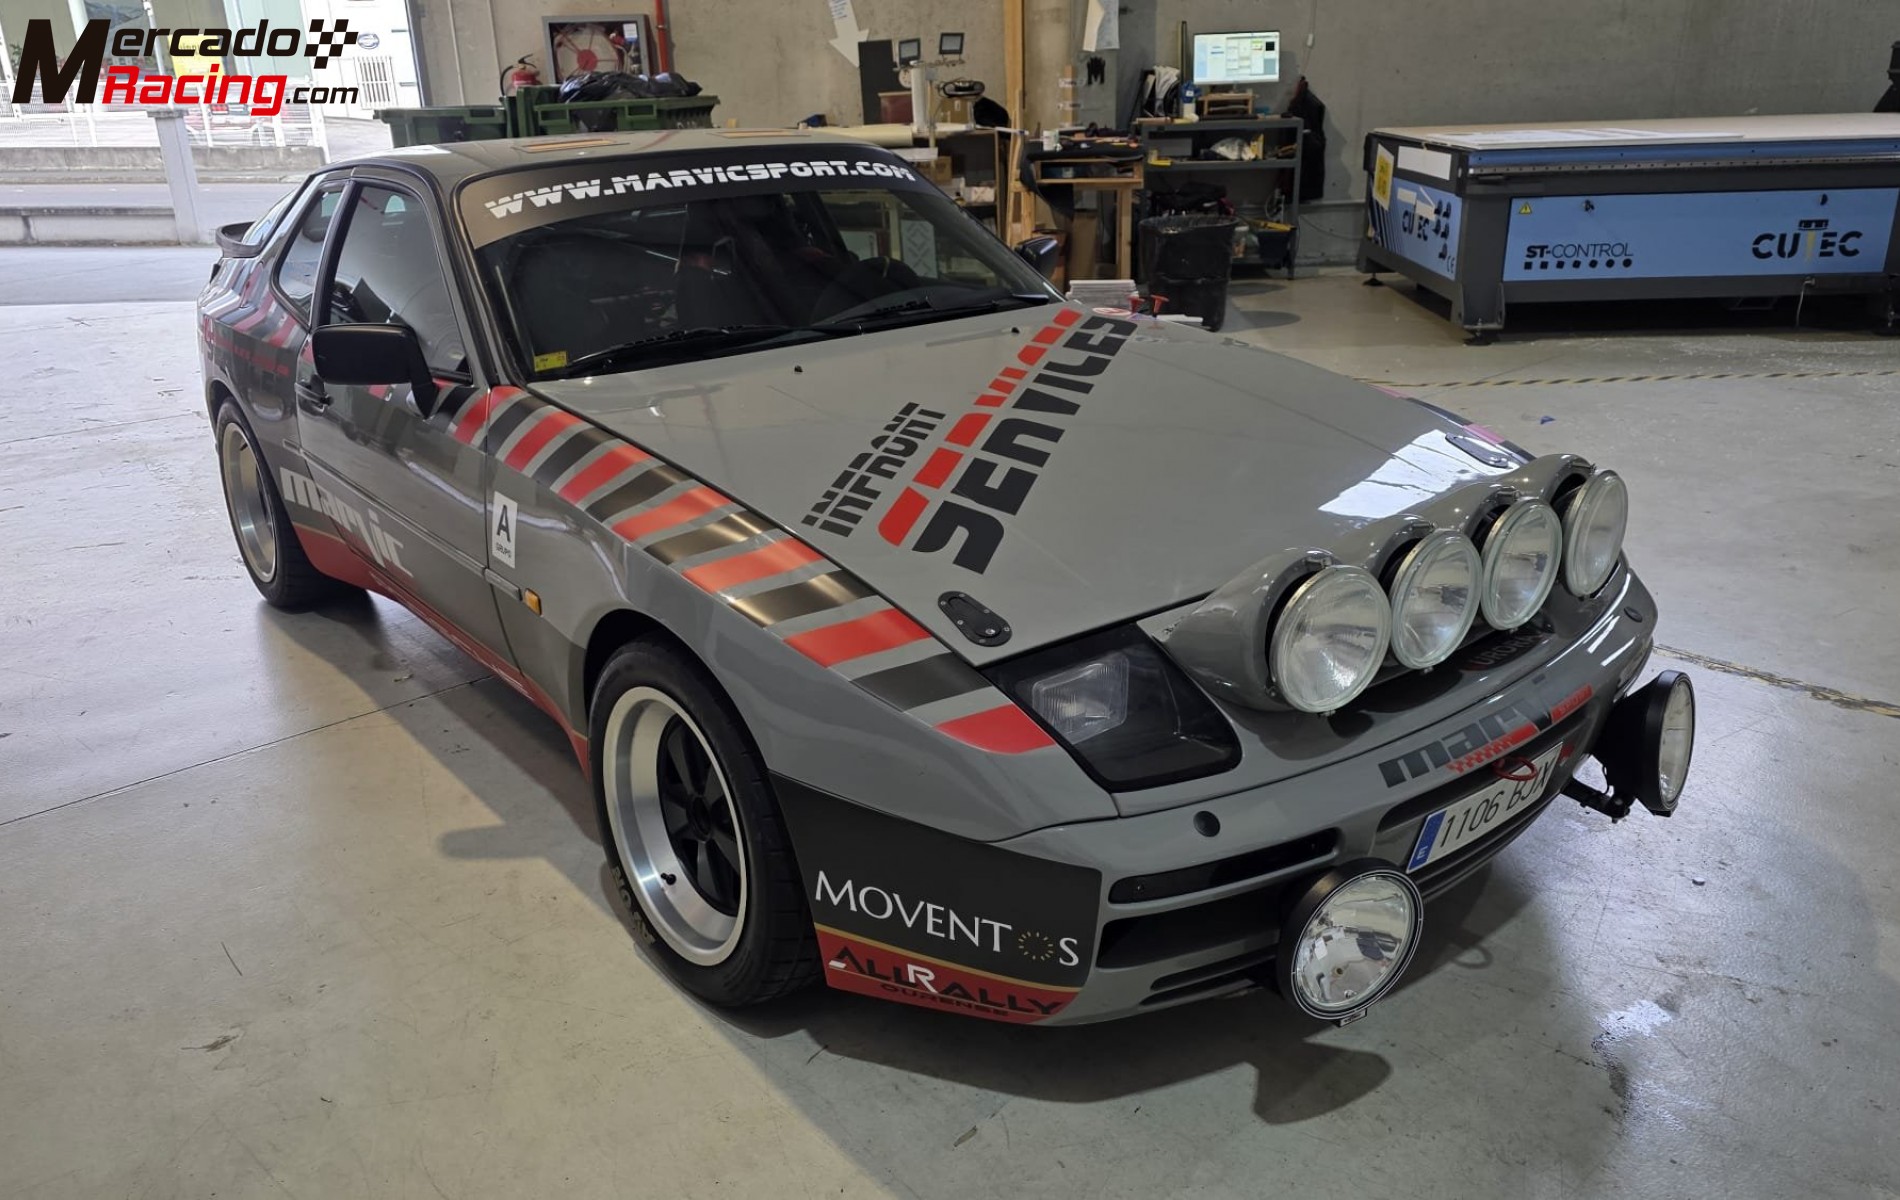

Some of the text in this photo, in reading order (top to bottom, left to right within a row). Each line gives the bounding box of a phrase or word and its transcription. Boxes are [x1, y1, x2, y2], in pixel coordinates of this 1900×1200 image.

[484, 160, 917, 219] WWW.MARVICSPORT.COM
[1402, 209, 1430, 242] CUEC
[1525, 243, 1634, 259] ST-CONTROL
[496, 504, 512, 543] A
[1440, 790, 1505, 848] 1106
